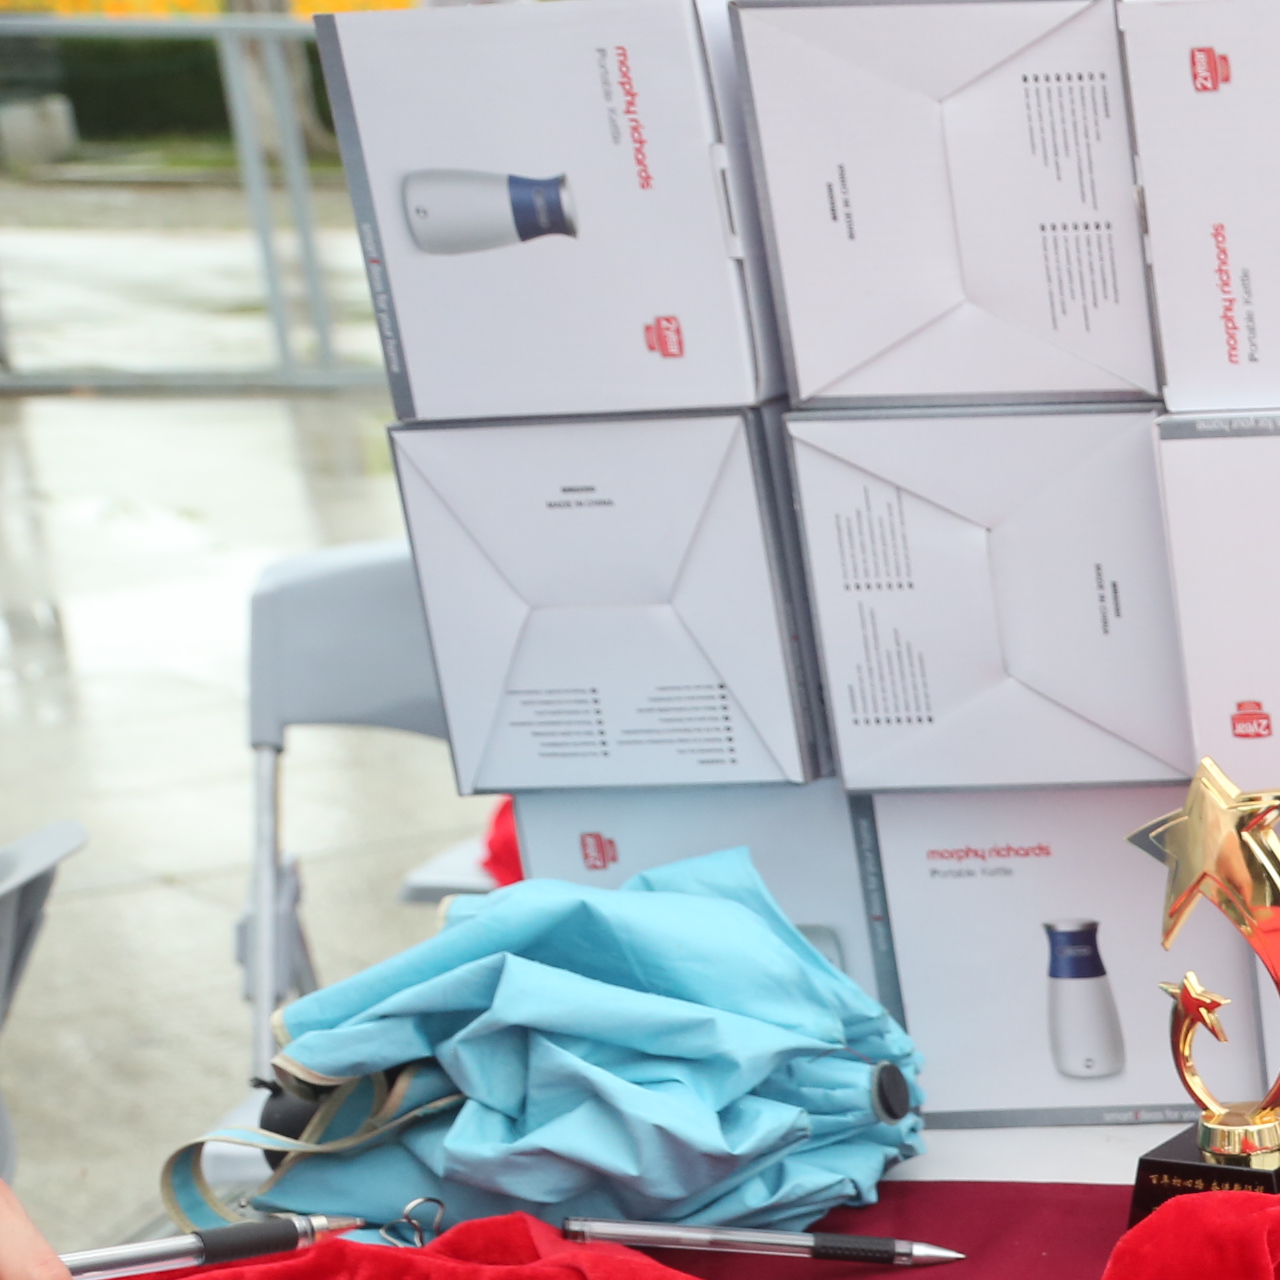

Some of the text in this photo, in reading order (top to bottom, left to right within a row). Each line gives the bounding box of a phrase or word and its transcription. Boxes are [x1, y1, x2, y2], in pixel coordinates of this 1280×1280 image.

[615, 46, 654, 190] morphy richards
[1211, 223, 1240, 364] morphy richards
[1239, 268, 1258, 362] Portable Kettle
[926, 843, 1051, 862] morphy richards
